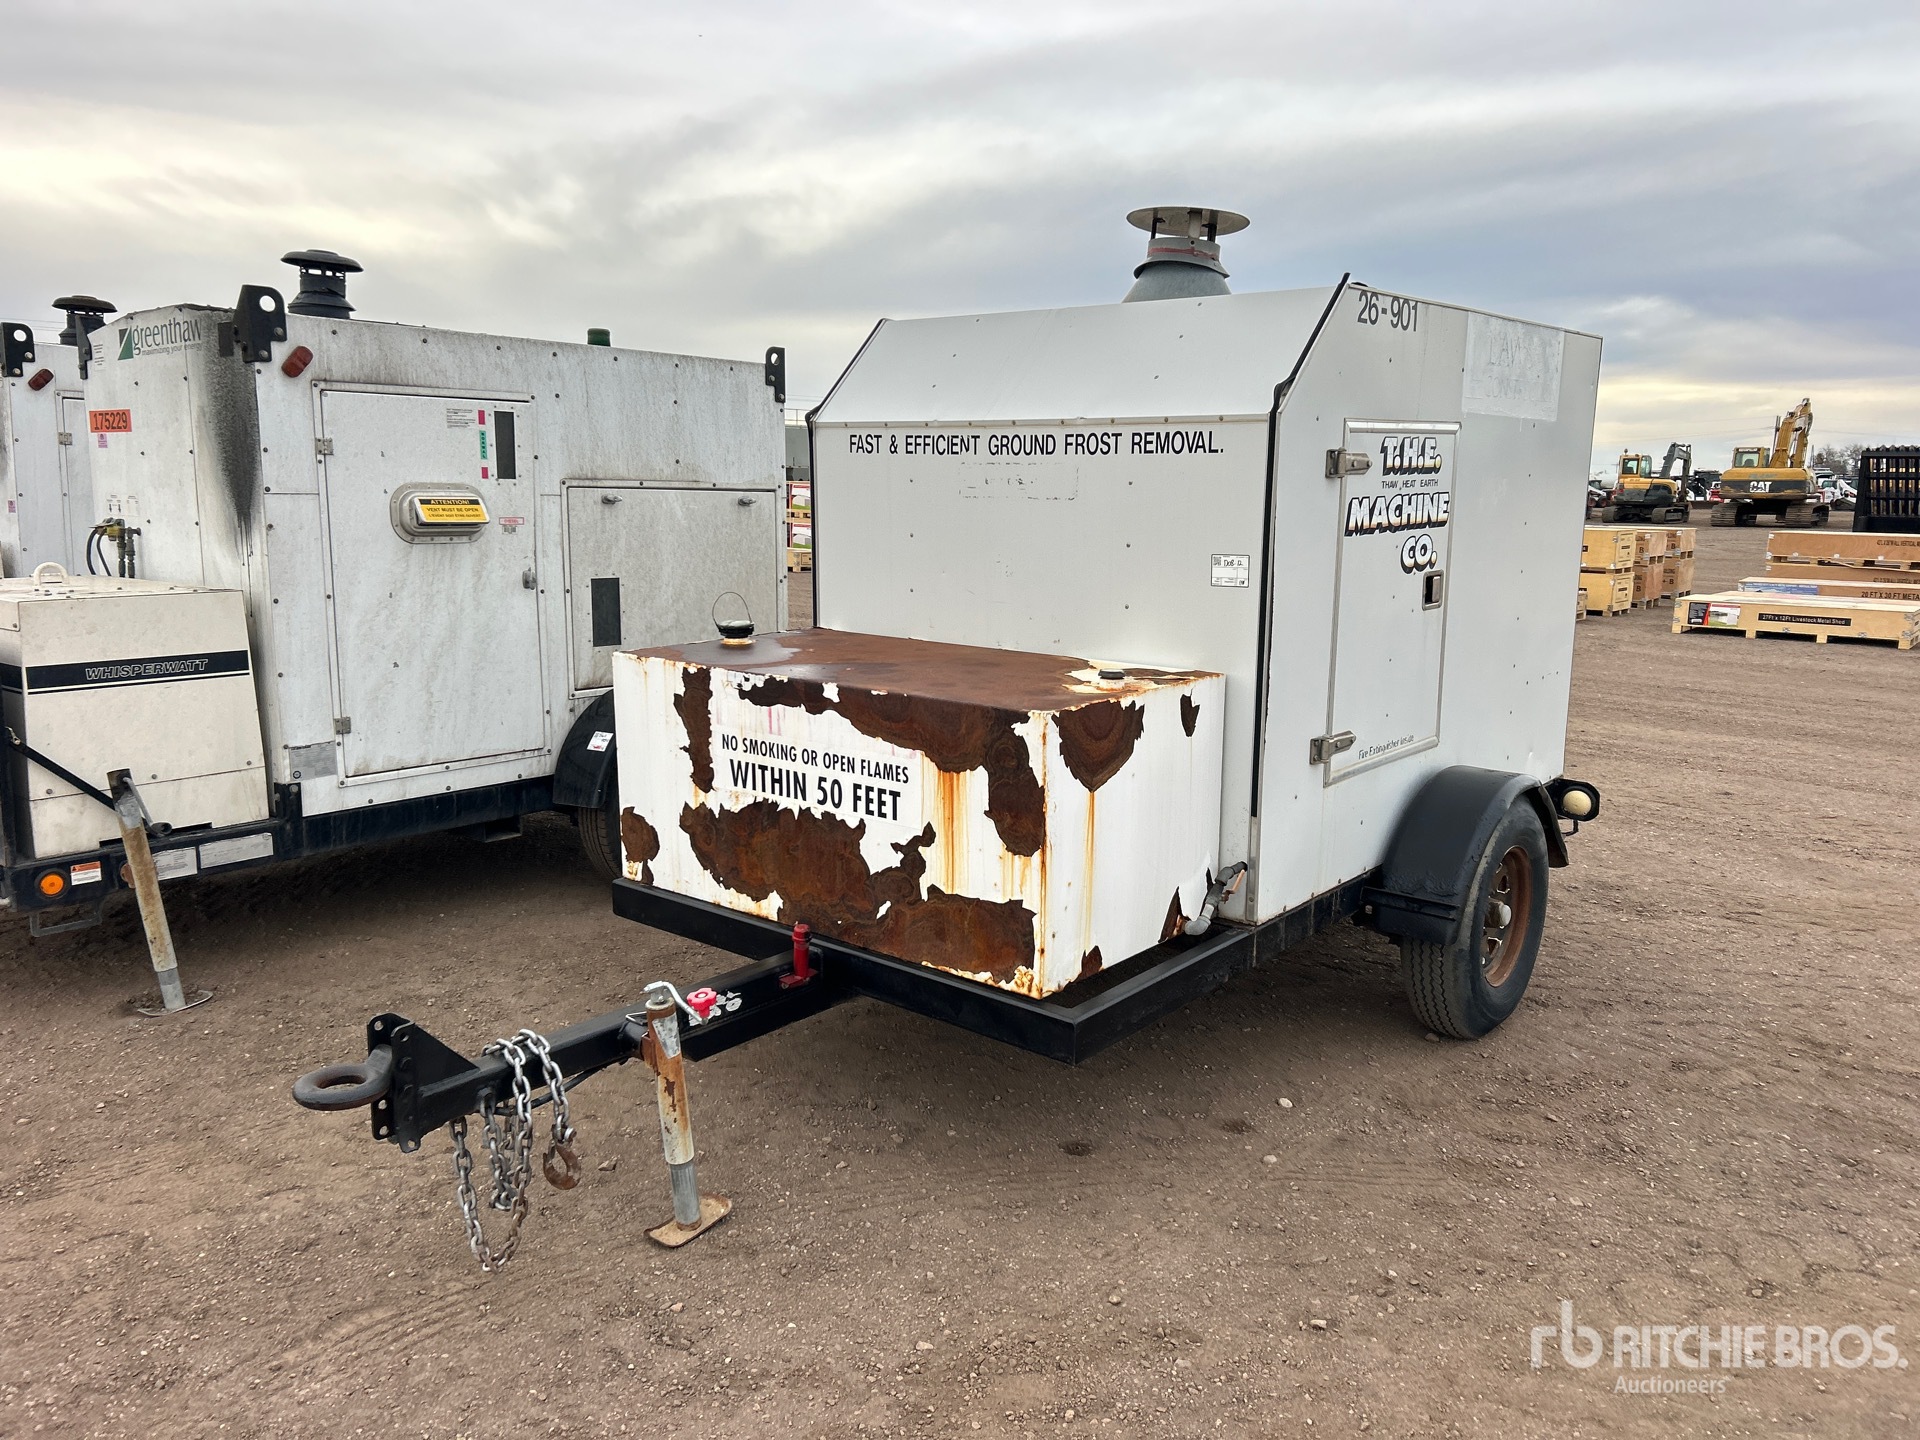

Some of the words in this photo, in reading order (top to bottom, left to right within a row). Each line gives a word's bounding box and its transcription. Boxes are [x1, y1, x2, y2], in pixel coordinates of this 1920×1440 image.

[1357, 290, 1418, 332] 26-901
[132, 317, 201, 355] greenthaw
[94, 411, 128, 430] 175229
[849, 435, 883, 454] FAST
[889, 435, 899, 454] &
[905, 434, 980, 455] EFFICIENT
[988, 434, 1056, 455] GROUND
[1064, 432, 1122, 455] FROST
[1131, 430, 1224, 455] REMOVAL.
[1380, 436, 1442, 476] T.H.E.
[1382, 480, 1398, 489] THAW
[1402, 479, 1416, 488] HEAT
[1420, 479, 1438, 487] EARTH
[1750, 481, 1772, 493] CAT
[1344, 492, 1449, 537] MACHINE
[1400, 533, 1437, 574] CO.
[85, 659, 208, 680] WHISPERWATT
[722, 733, 738, 751] NO
[742, 737, 797, 763] SMOKING
[801, 748, 818, 767] OR
[822, 752, 855, 774] OPEN
[860, 759, 909, 784] FLAMES
[729, 758, 807, 802] WITHIN
[817, 776, 842, 809] 50
[852, 783, 901, 821] FEET
